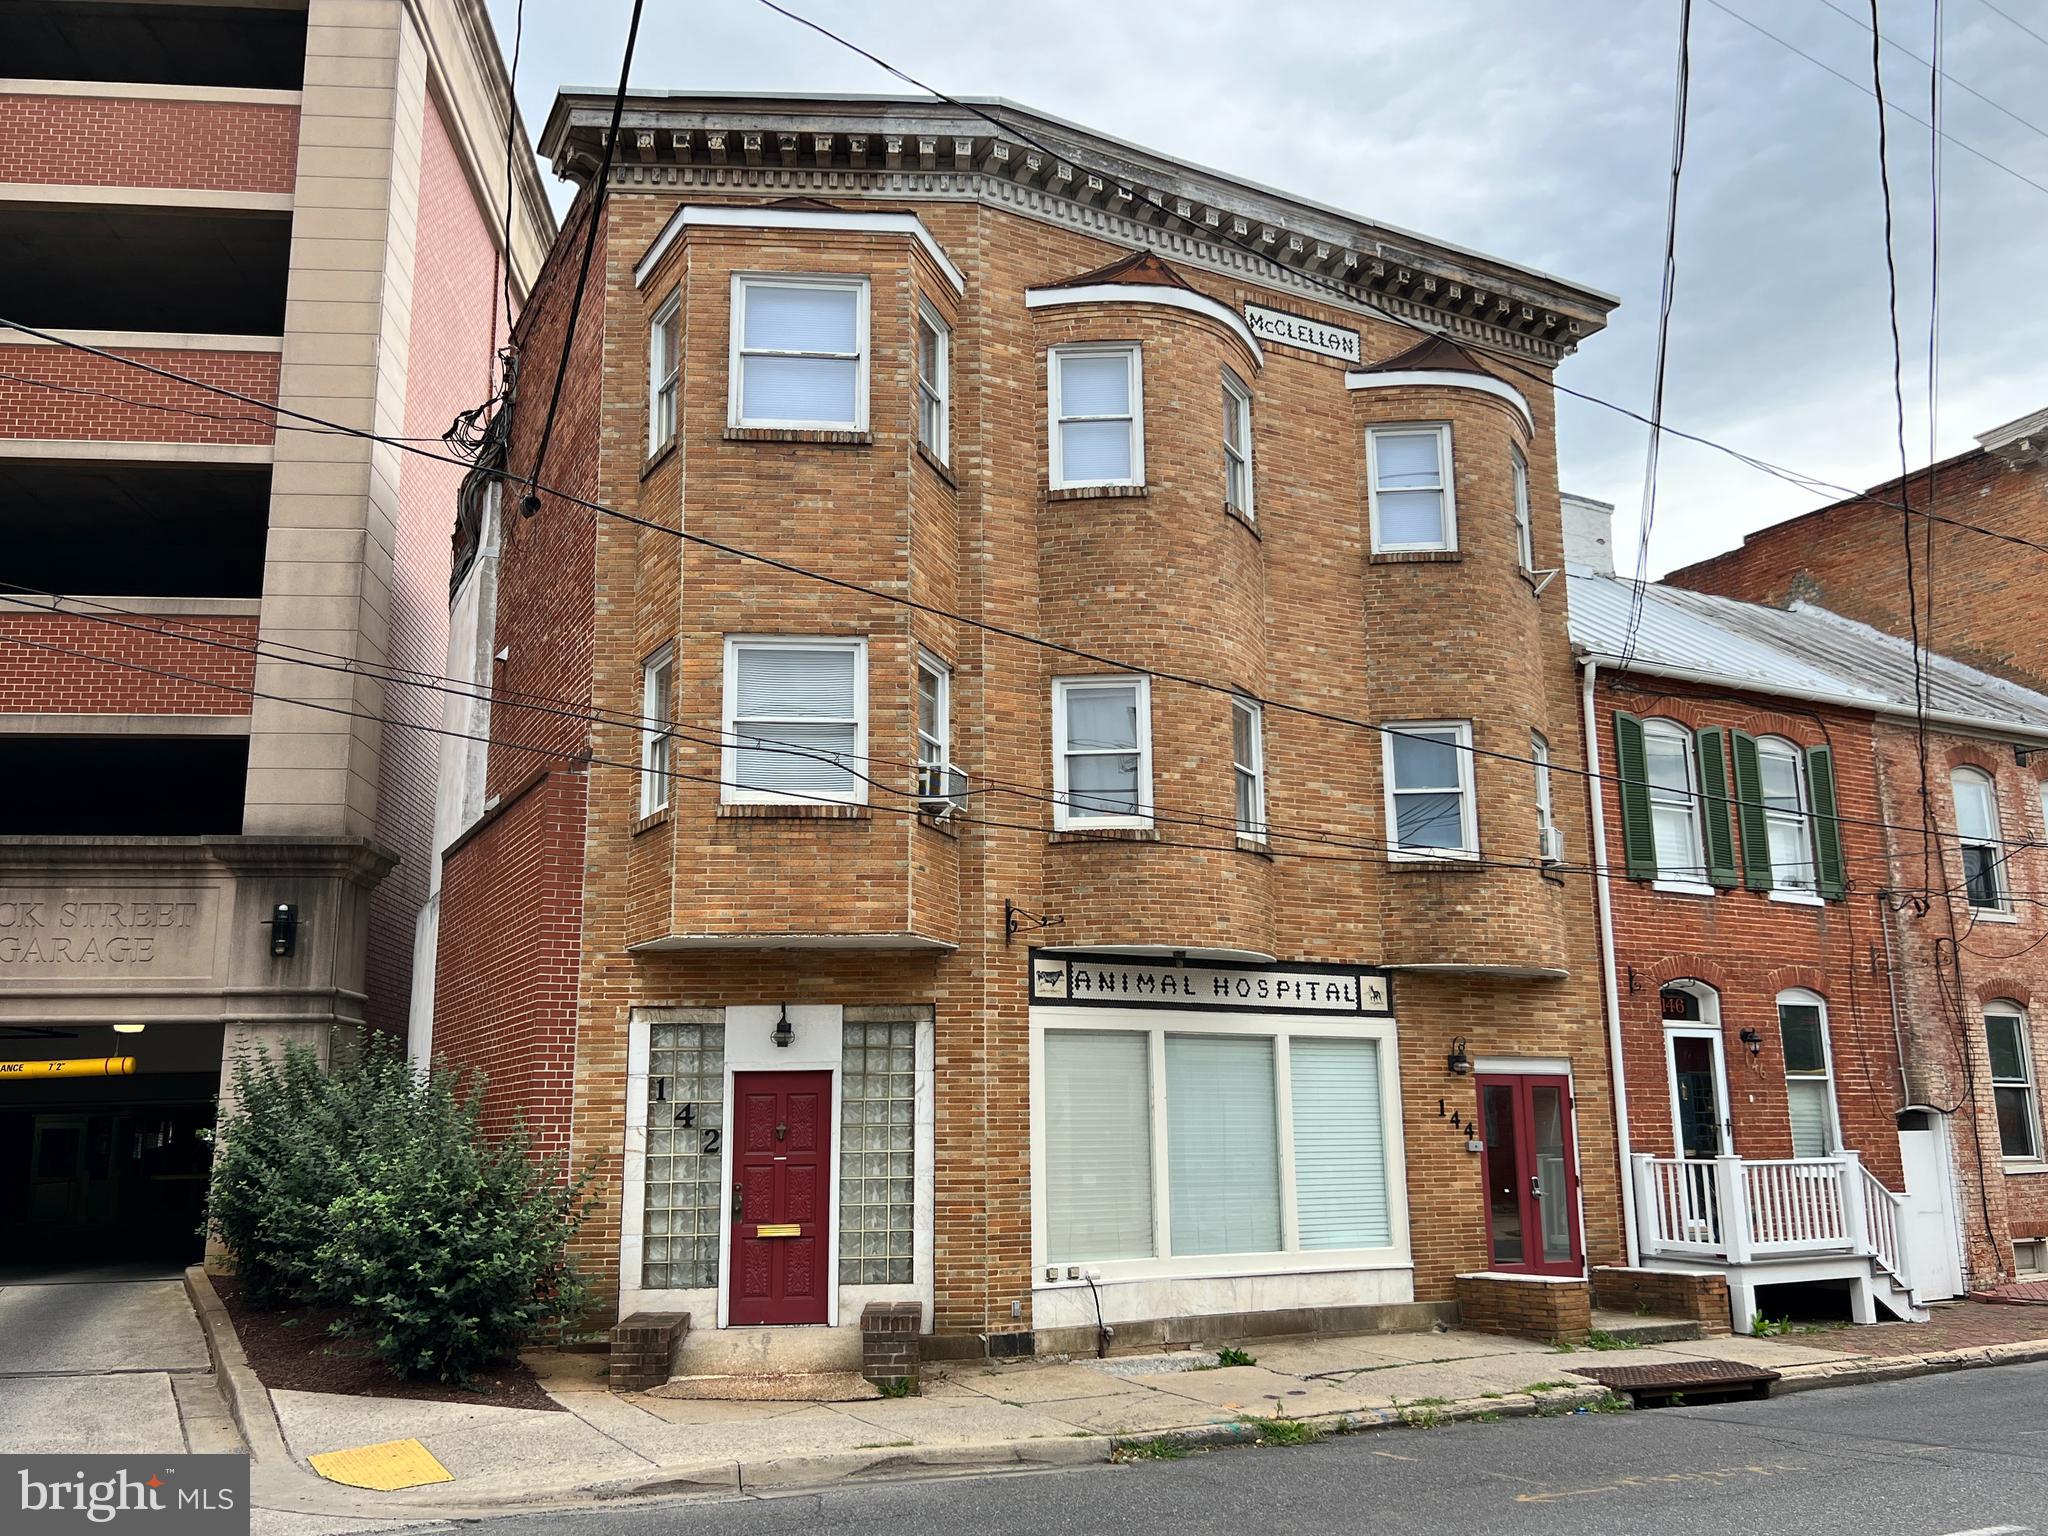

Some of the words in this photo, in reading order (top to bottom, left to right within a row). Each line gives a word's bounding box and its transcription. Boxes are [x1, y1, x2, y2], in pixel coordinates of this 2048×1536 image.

[1248, 311, 1354, 355] McCLELLAN
[0, 902, 45, 928] CK
[59, 902, 198, 928] STREET
[0, 936, 155, 963] GARAGE
[1074, 969, 1196, 996] ANIMAL
[1213, 976, 1356, 1003] HOSPITAL
[1662, 998, 1685, 1014] 146
[0, 1063, 24, 1072] ANCE
